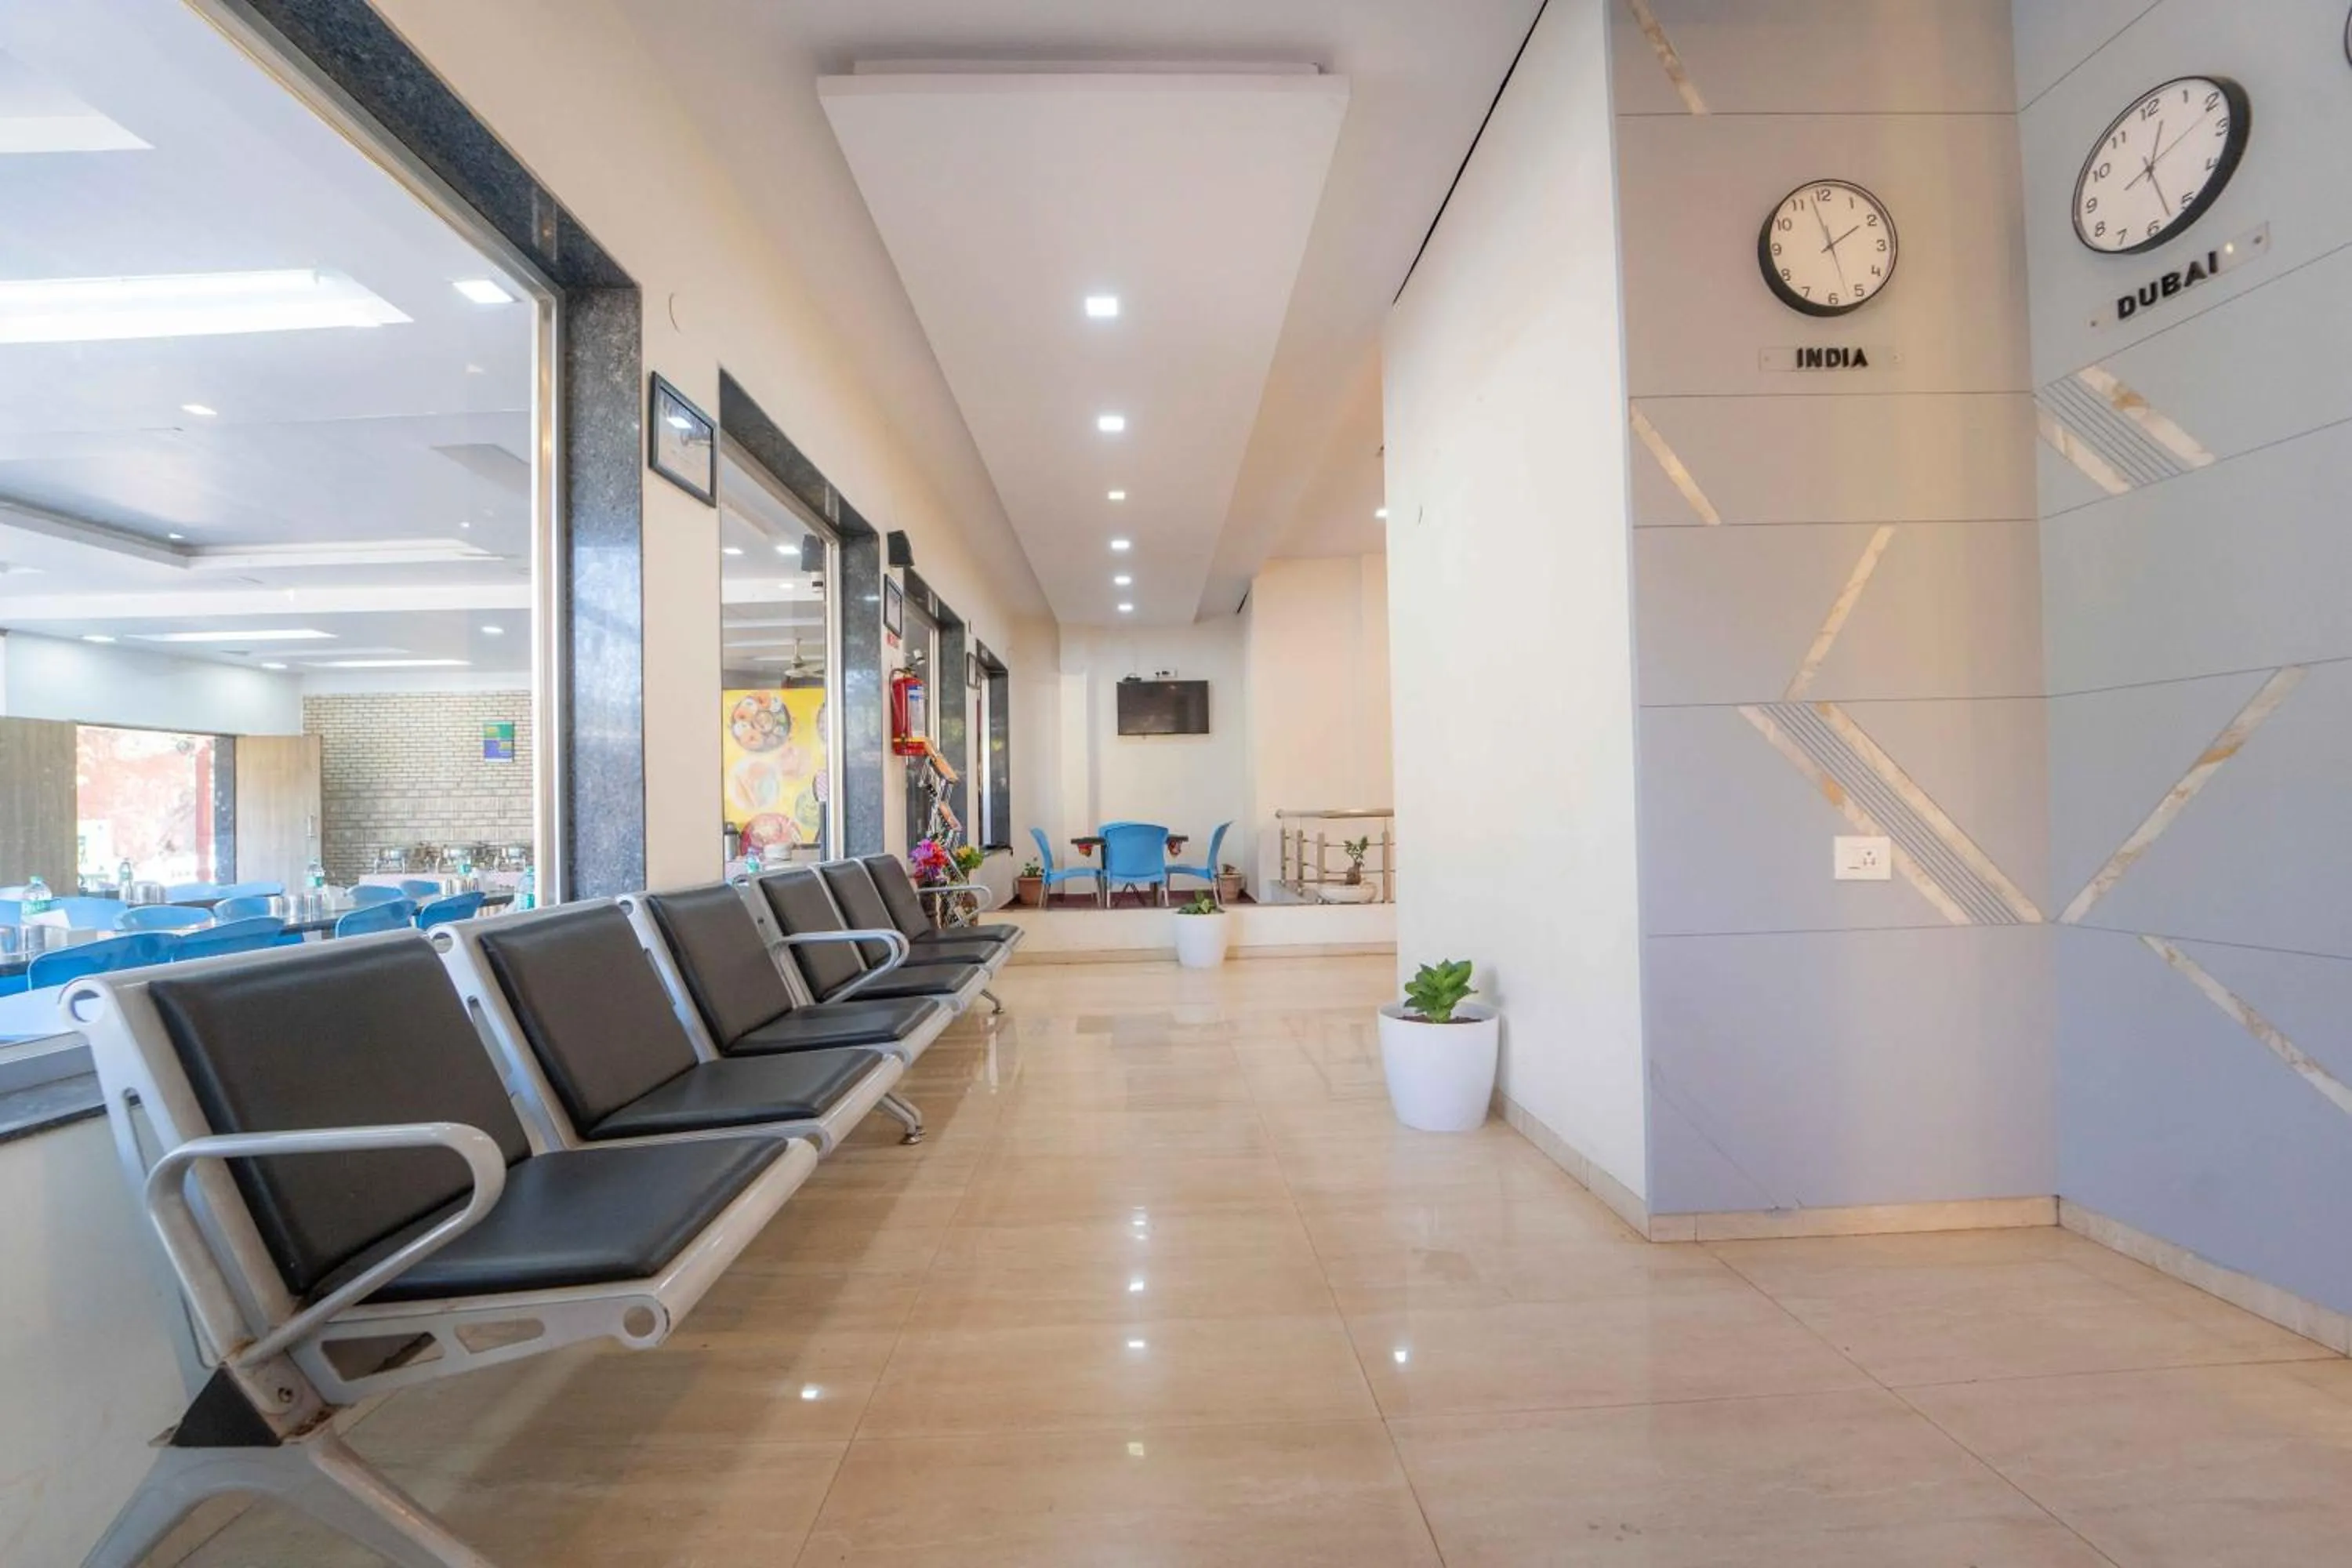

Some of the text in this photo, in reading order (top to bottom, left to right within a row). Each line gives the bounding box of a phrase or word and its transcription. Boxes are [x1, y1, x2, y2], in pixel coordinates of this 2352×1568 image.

[2183, 89, 2188, 103] 1
[2205, 92, 2220, 112] 2
[2140, 98, 2160, 121] 12
[2216, 118, 2229, 136] 3
[2111, 130, 2126, 149] 11
[2092, 162, 2111, 183] 10
[1816, 188, 1831, 202] 12
[1791, 199, 1805, 212] 11
[1849, 197, 1854, 209] 1
[2085, 197, 2097, 214] 9
[1777, 217, 1792, 230] 10
[1867, 214, 1877, 227] 2
[2094, 220, 2106, 238] 8
[2147, 220, 2160, 236] 6
[2118, 228, 2127, 245] 7
[1772, 243, 1782, 256] 9
[1876, 239, 1886, 252] 3
[1780, 268, 1791, 281] 8
[1871, 265, 1881, 276] 4
[1801, 286, 1810, 298] 7
[1853, 284, 1864, 296] 5
[2118, 251, 2218, 321] DUBAI
[1828, 292, 1838, 305] 6
[1797, 347, 1868, 368] INDIA
